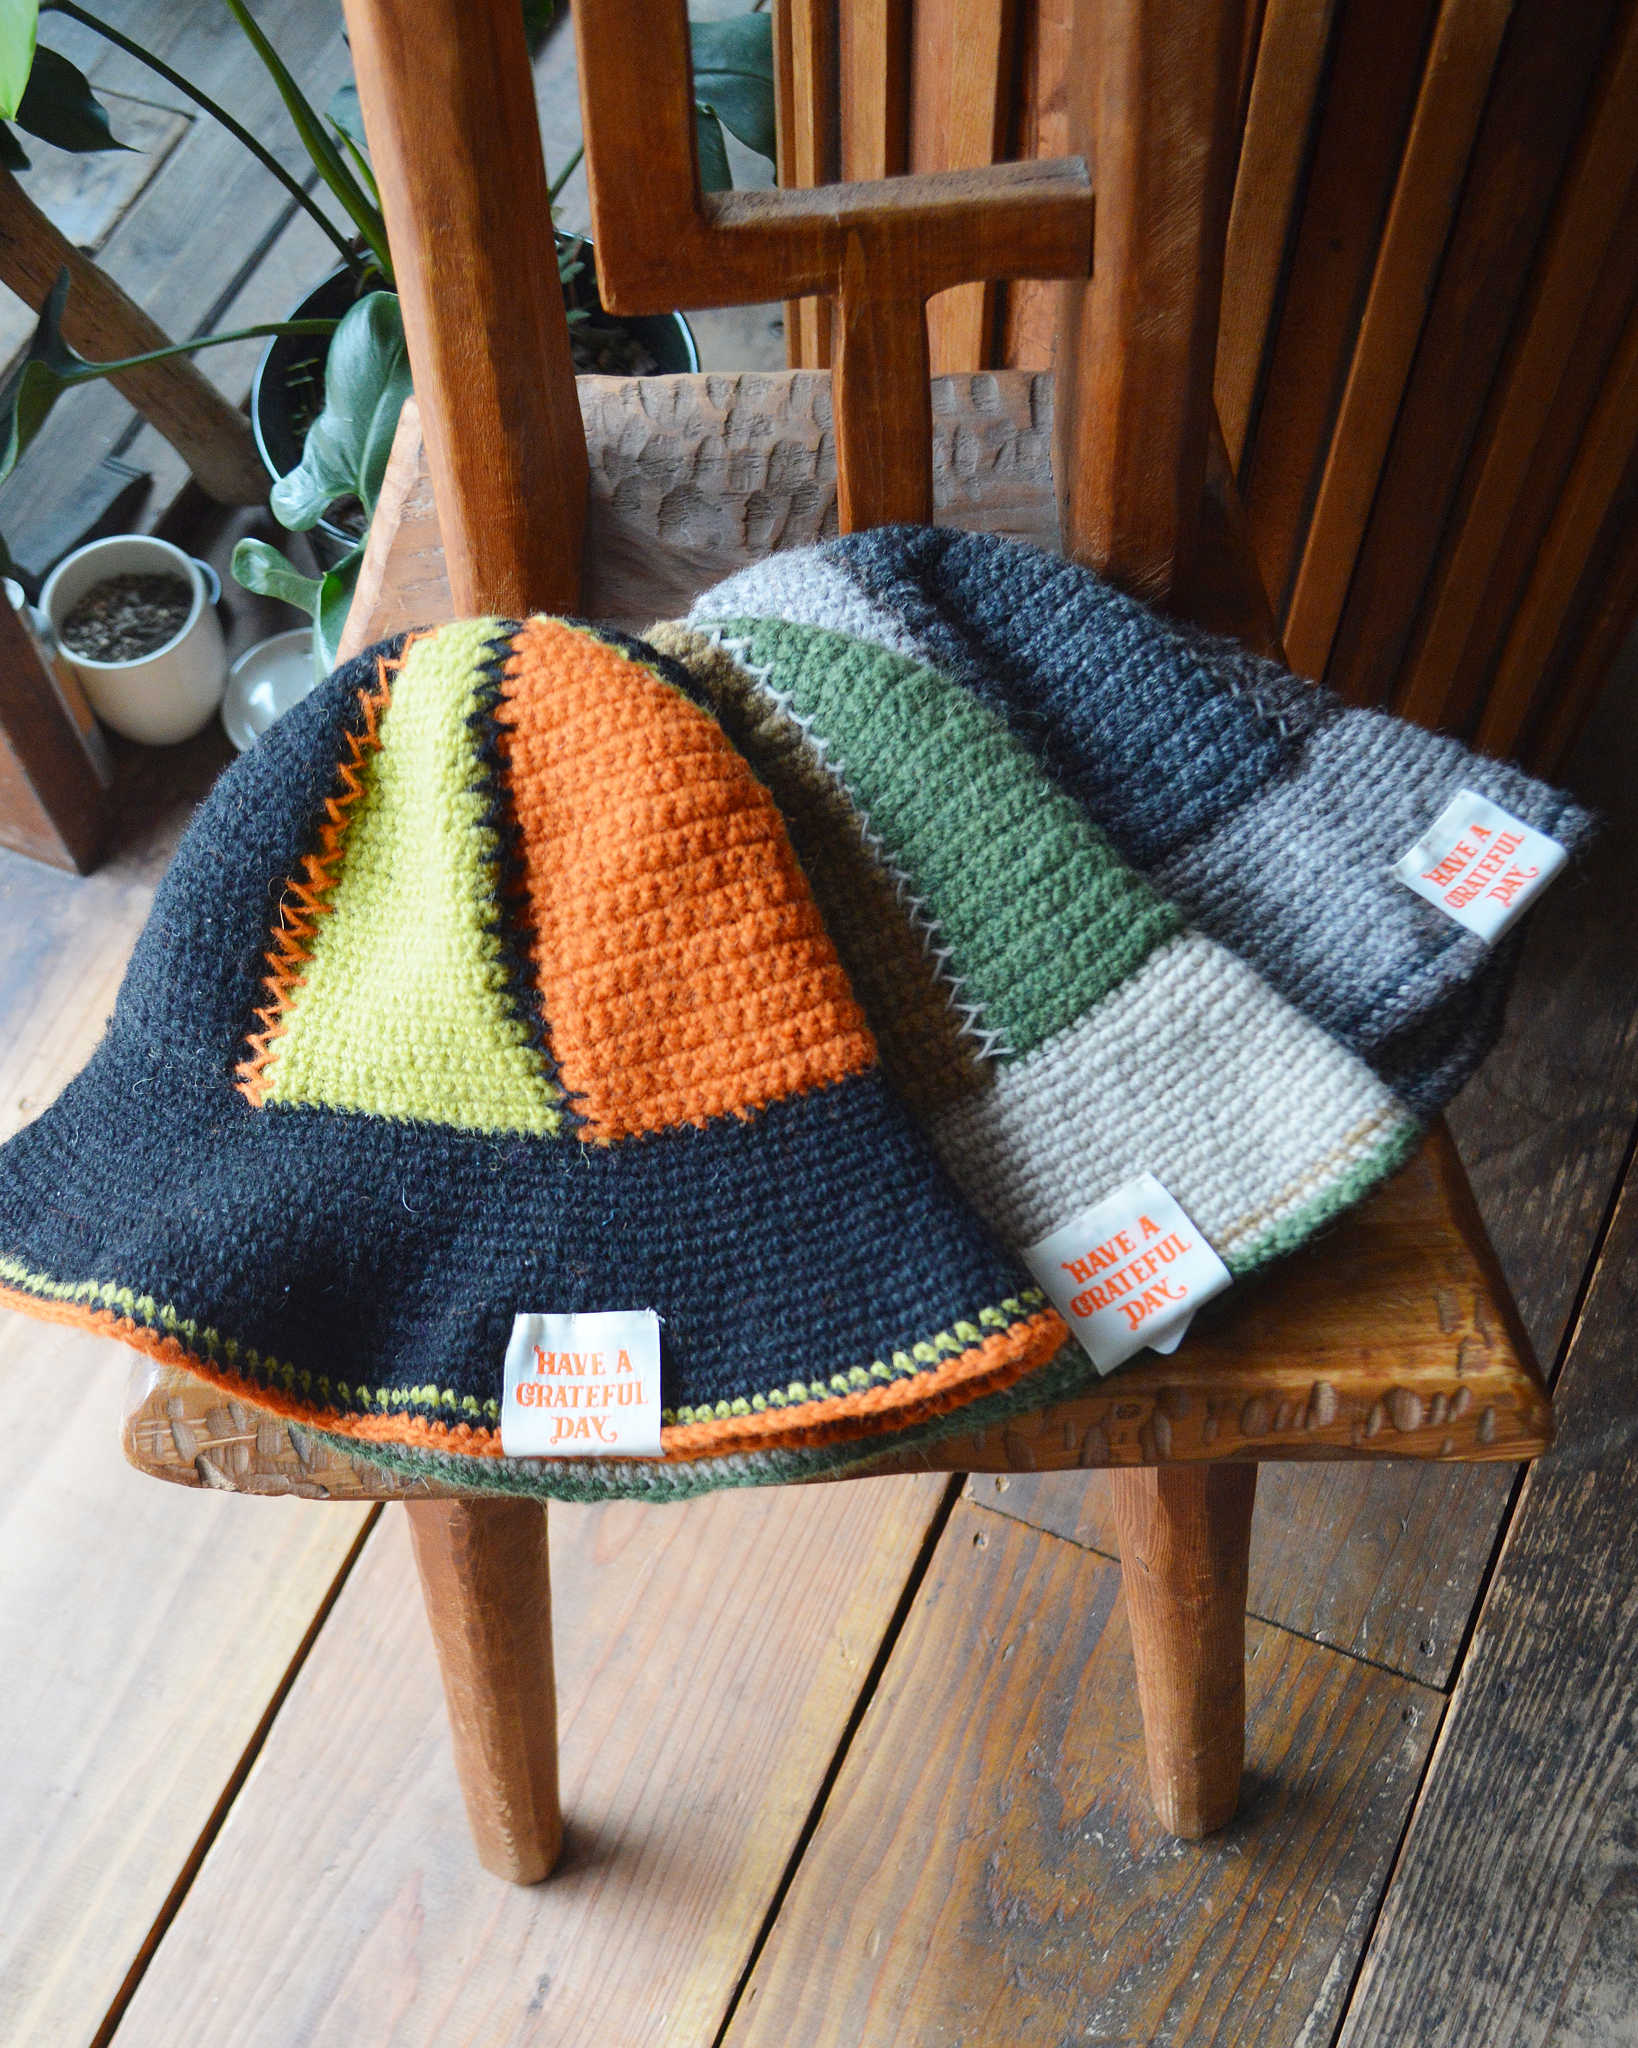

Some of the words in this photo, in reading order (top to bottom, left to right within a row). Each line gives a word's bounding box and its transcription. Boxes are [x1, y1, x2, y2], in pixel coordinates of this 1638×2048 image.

[1421, 840, 1480, 887] HAVE
[1469, 824, 1493, 843] A
[1443, 831, 1526, 909] GRATEFUL
[1485, 863, 1541, 908] DAY
[1060, 1230, 1136, 1285] HAVE
[1138, 1215, 1161, 1240] A
[1069, 1232, 1192, 1318] GRATEFUL
[1116, 1276, 1188, 1331] DAY
[533, 1345, 606, 1376] HAVE
[616, 1349, 634, 1374] A
[515, 1381, 648, 1409] GRATEFUL
[550, 1415, 618, 1445] DAY
